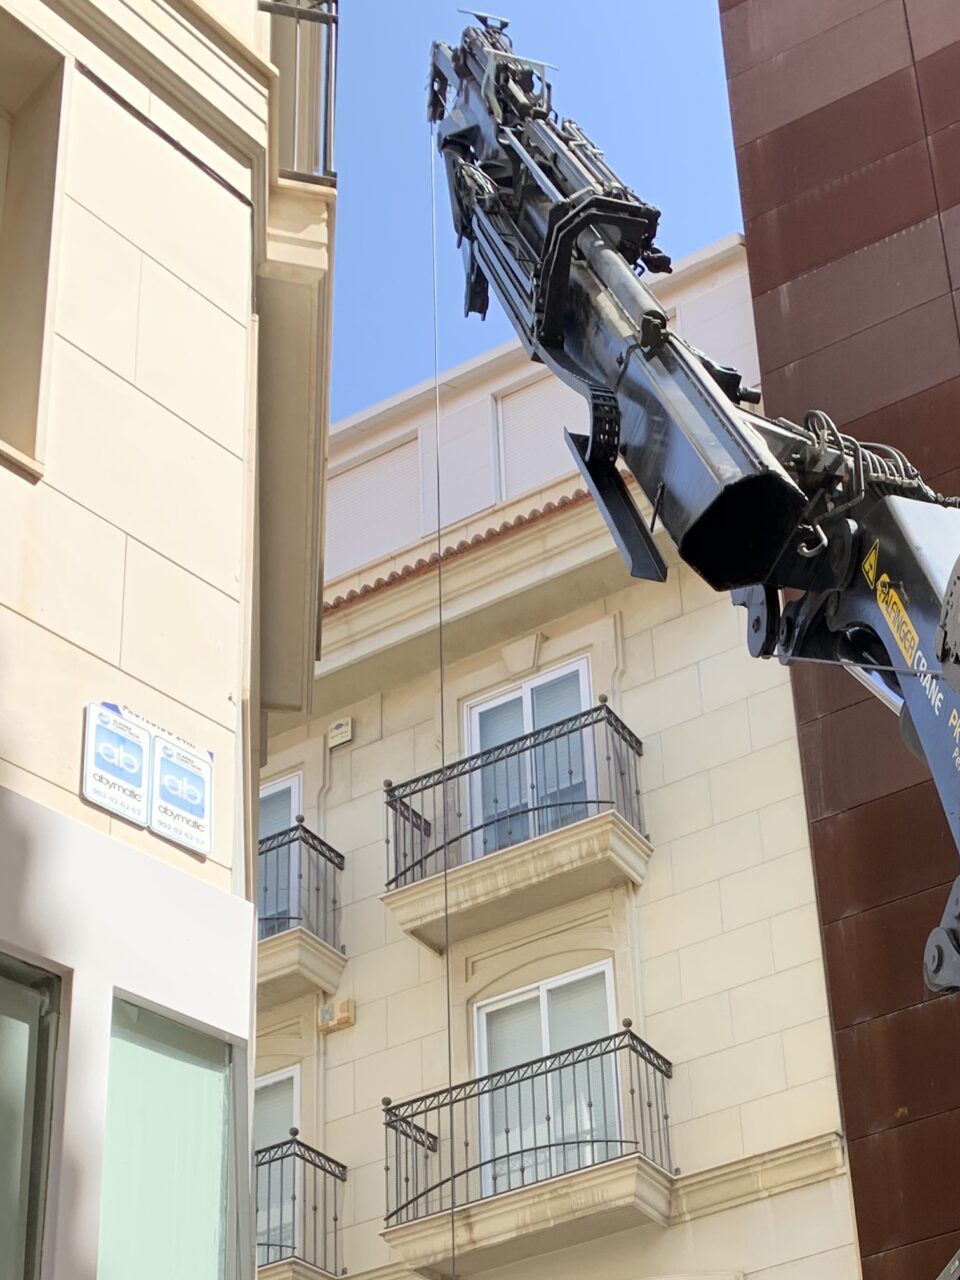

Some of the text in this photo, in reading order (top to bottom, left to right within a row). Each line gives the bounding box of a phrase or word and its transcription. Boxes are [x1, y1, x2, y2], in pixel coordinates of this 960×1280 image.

[913, 650, 944, 716] CRANE
[93, 773, 143, 802] abymatic
[157, 804, 205, 832] abymatic
